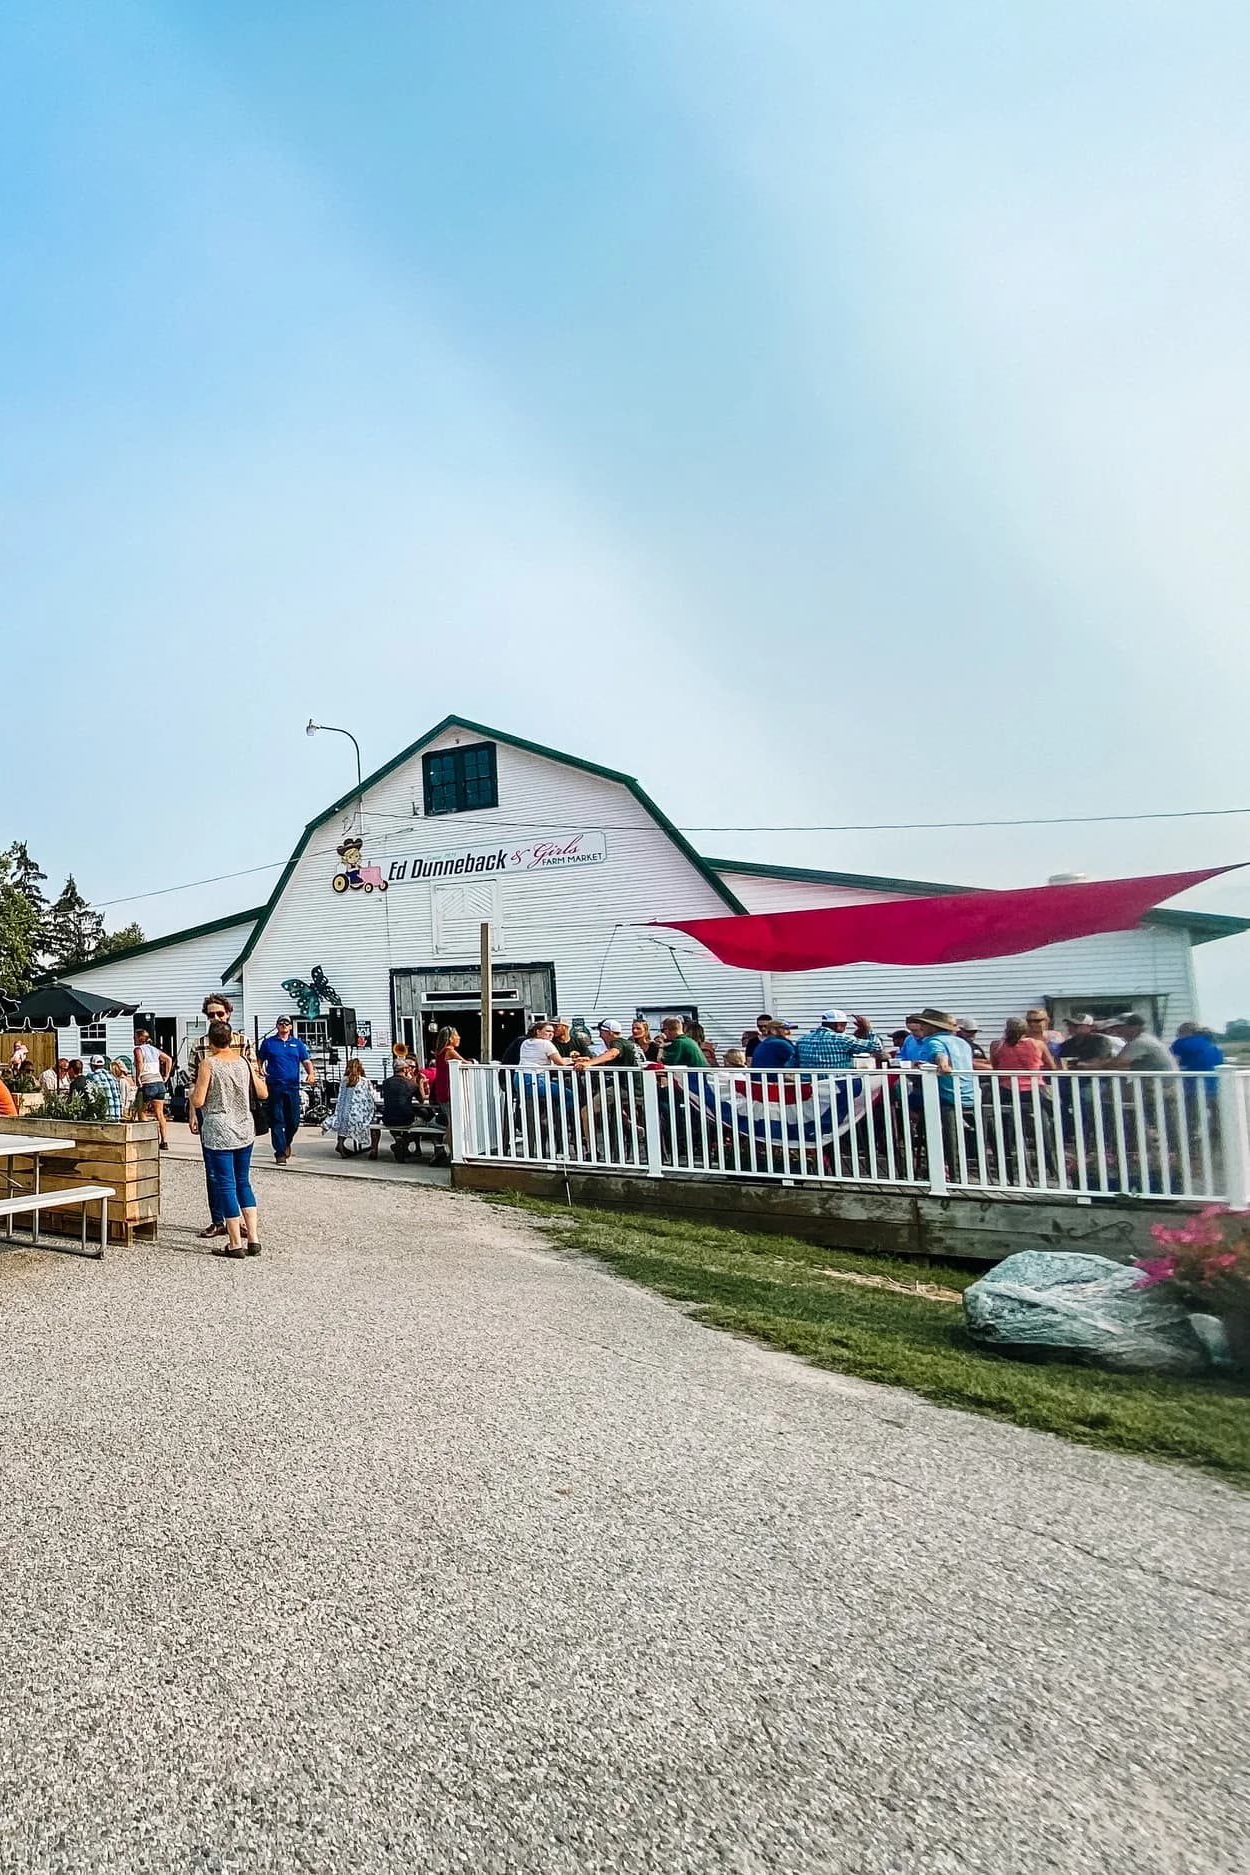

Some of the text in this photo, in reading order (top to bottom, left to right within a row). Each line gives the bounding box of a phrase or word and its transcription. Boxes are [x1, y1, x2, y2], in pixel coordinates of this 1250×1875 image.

[388, 834, 584, 881] Ed Dunneback & Girls
[542, 852, 603, 867] FARM MARKET
